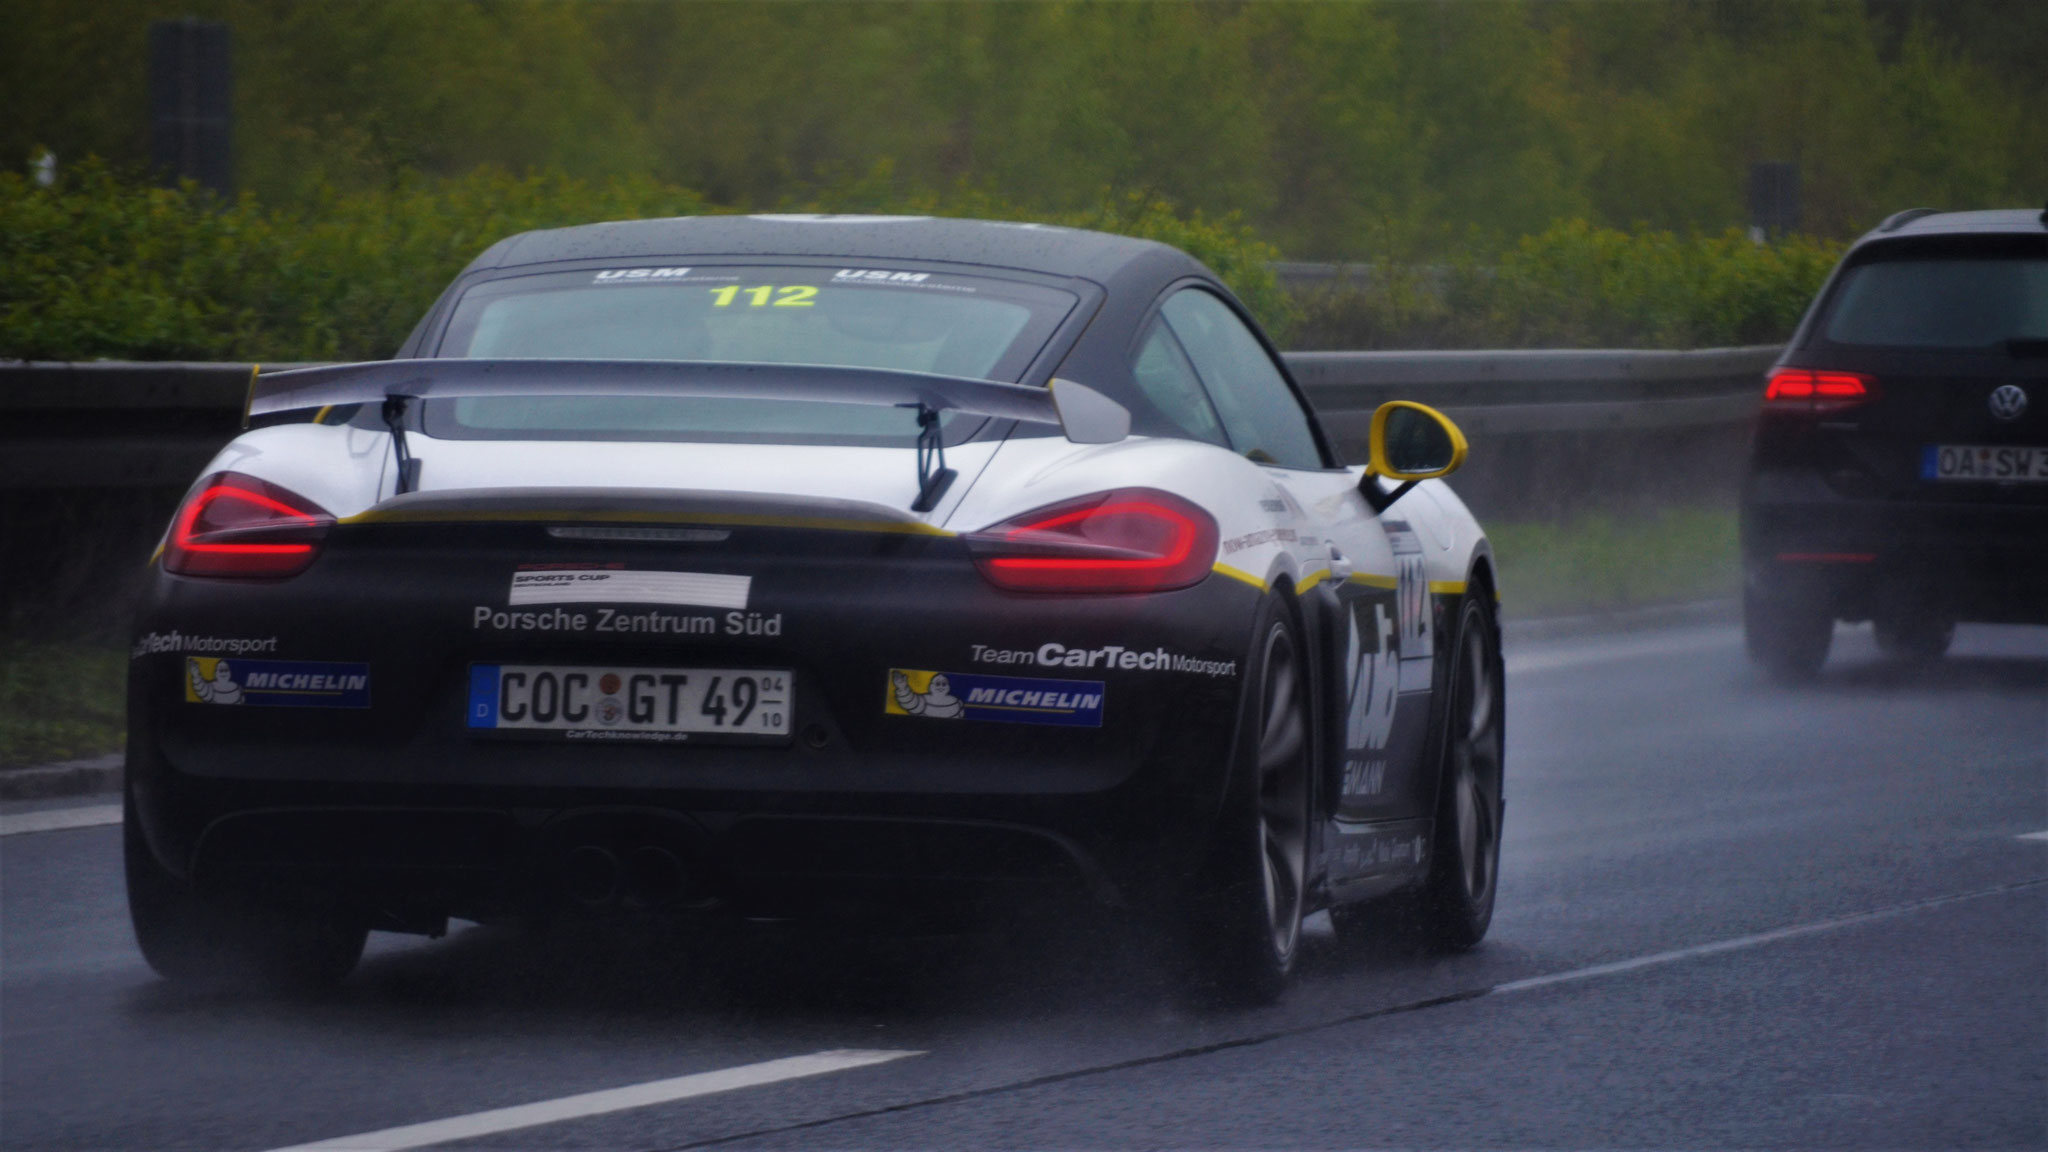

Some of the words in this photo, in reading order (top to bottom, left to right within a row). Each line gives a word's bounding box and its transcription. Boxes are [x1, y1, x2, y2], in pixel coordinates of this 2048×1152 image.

[595, 267, 691, 279] USM
[834, 268, 931, 282] USM
[709, 285, 819, 307] 112
[515, 574, 575, 583] SPORTS
[578, 573, 611, 581] CUP
[473, 606, 588, 631] Porsche
[595, 608, 716, 634] Zentrum
[725, 611, 783, 637] Süd
[184, 634, 278, 655] Motorsport
[971, 644, 1035, 664] Team
[1037, 642, 1171, 671] CarTech
[1172, 653, 1237, 678] Motorsport
[245, 672, 367, 691] MICHELIN
[762, 676, 784, 691] 04
[501, 671, 589, 723] COC
[628, 673, 688, 725] GT
[701, 675, 758, 727] 49
[967, 687, 1102, 710] MICHELIN
[476, 703, 489, 718] D
[763, 712, 782, 727] 10
